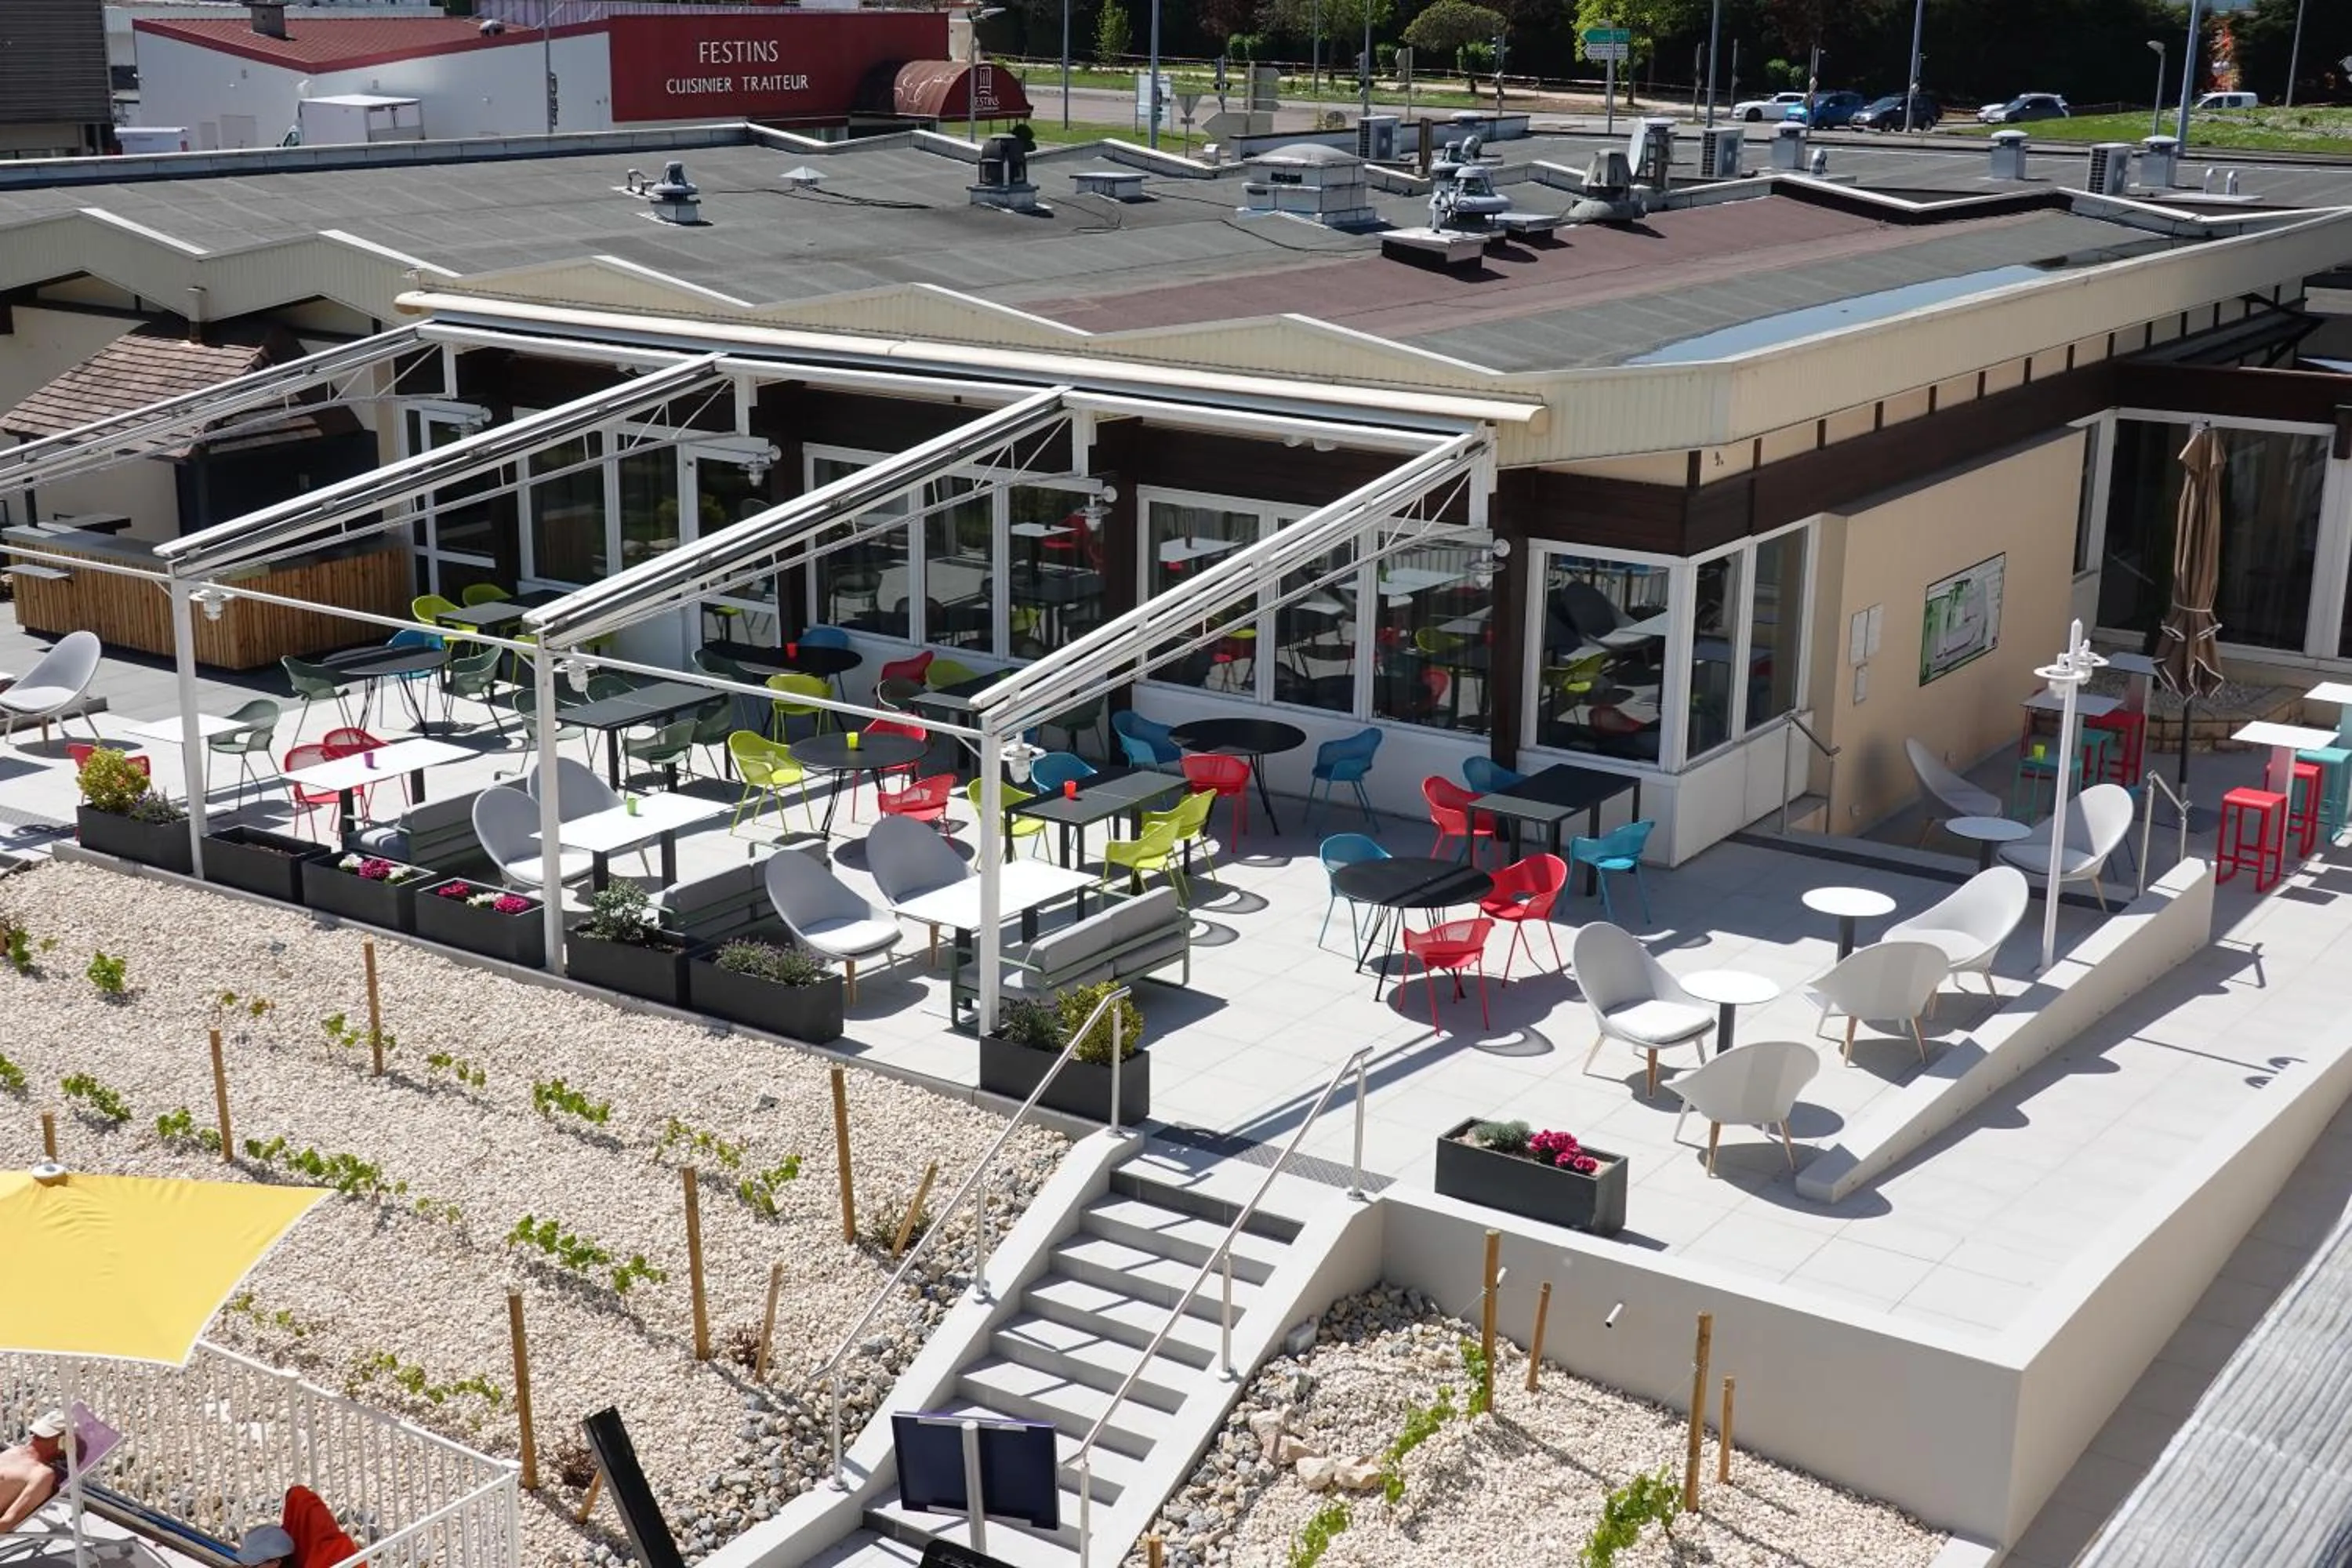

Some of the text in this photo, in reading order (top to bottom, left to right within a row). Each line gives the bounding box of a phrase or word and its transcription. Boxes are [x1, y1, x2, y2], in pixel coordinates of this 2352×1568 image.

[699, 41, 779, 64] FESTINS
[666, 74, 809, 94] CUISINIER TRAITEUR
[972, 96, 1000, 107] ESTINS
